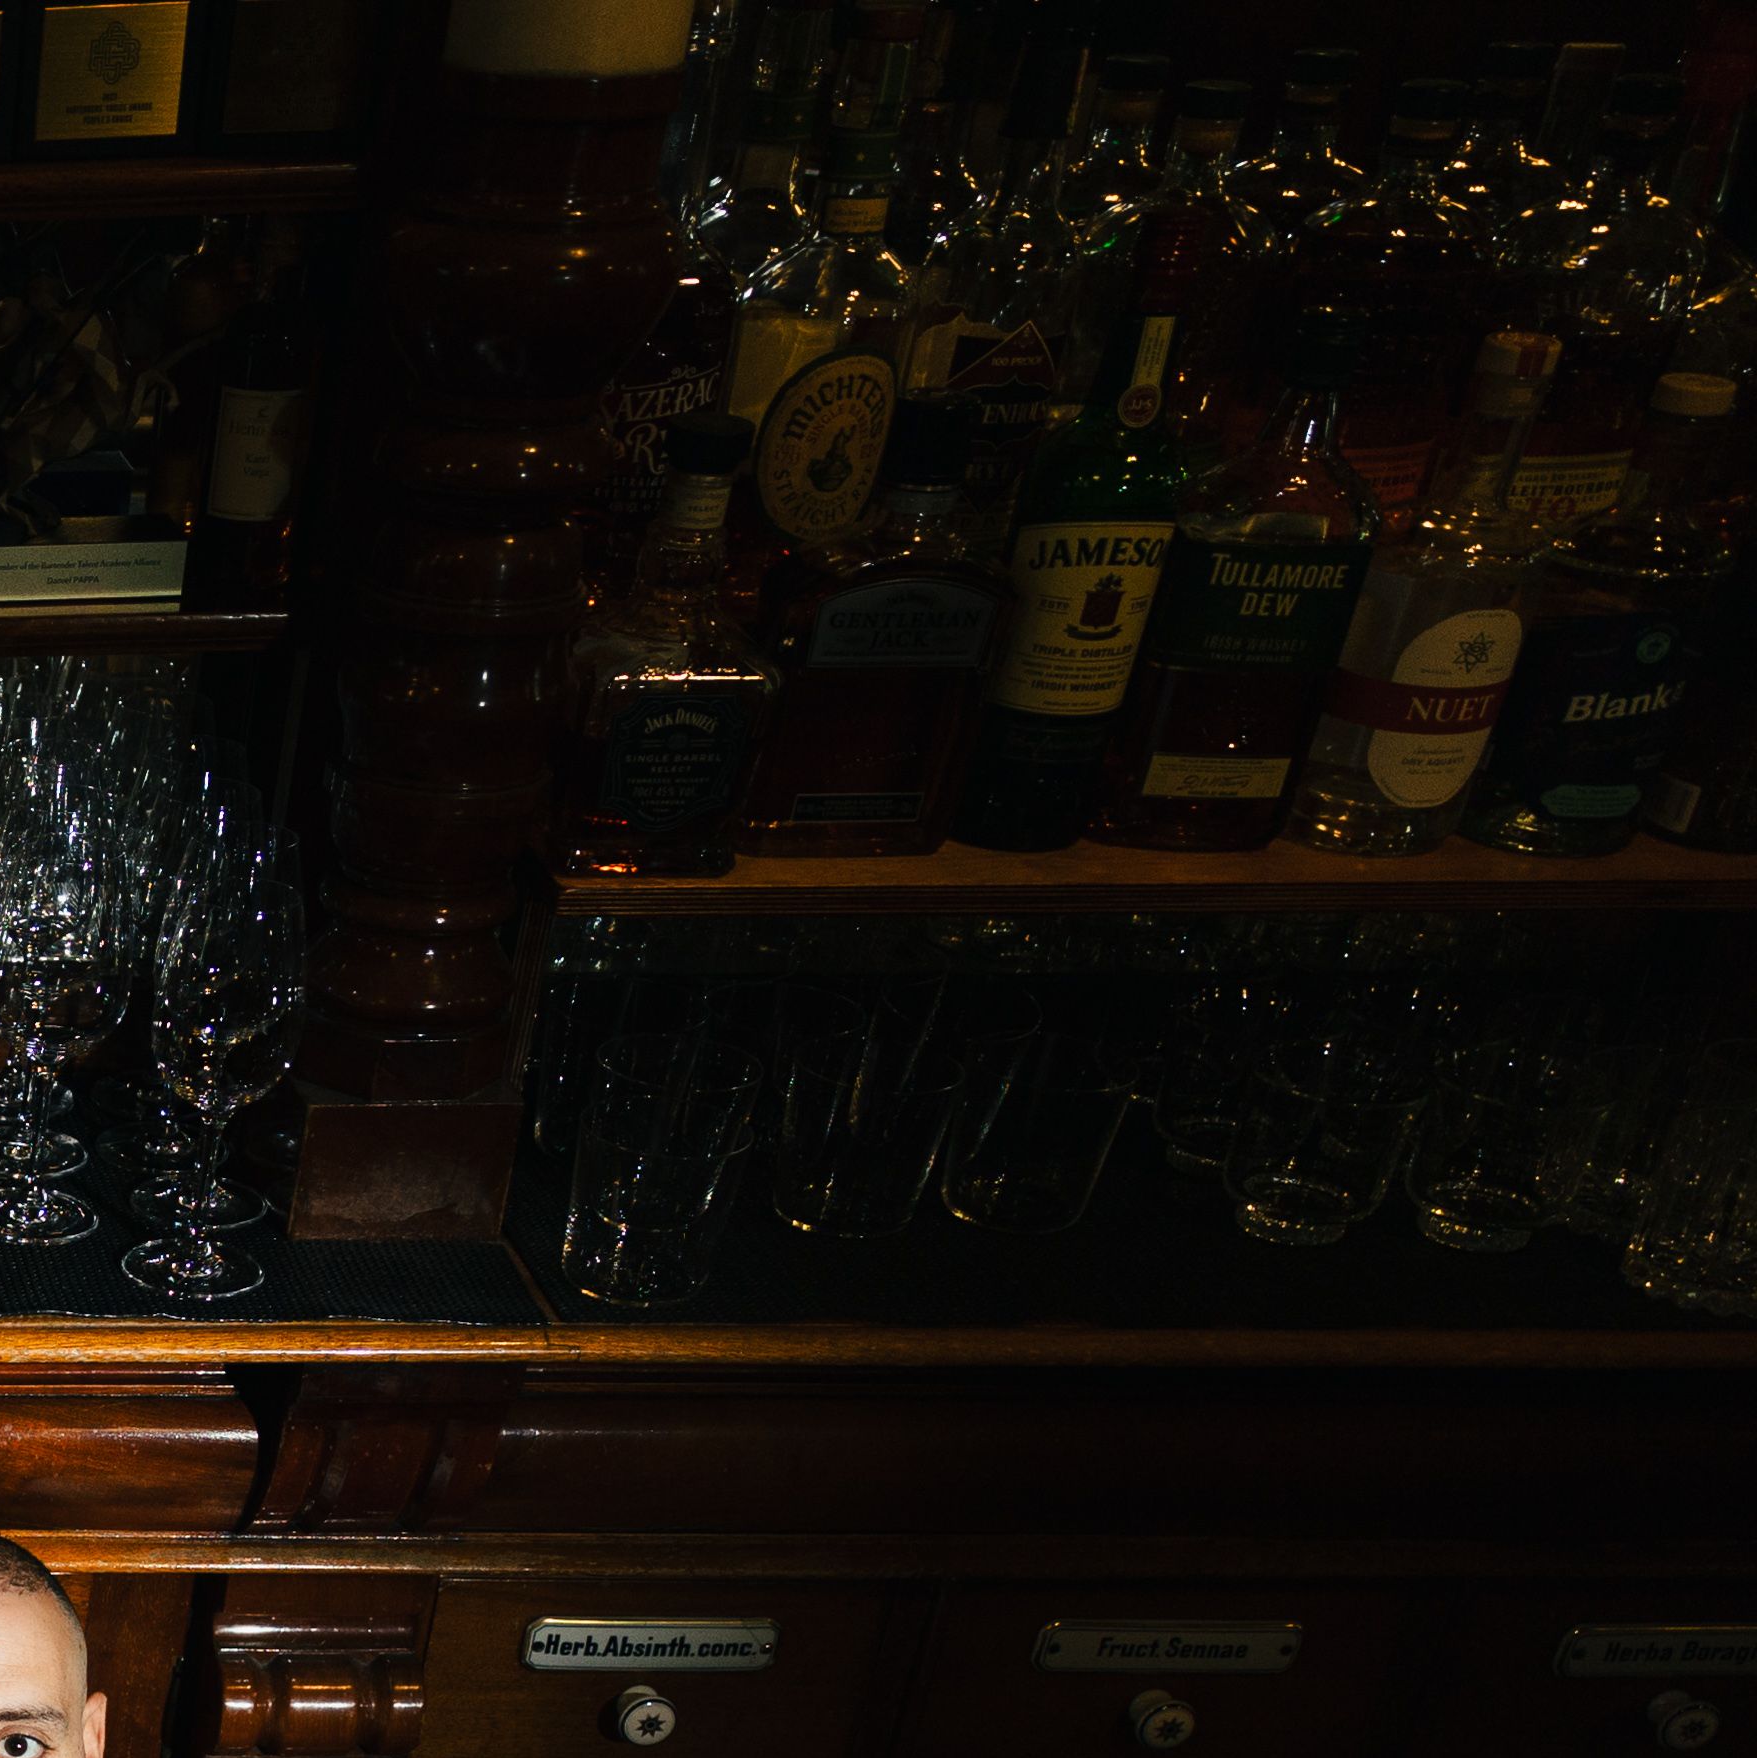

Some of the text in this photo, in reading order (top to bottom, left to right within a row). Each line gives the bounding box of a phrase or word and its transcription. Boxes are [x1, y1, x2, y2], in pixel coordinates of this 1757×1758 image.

[1028, 536, 1167, 570] JAMESO
[1209, 552, 1350, 589] TULLAMORE
[1238, 591, 1301, 618] DEW
[830, 609, 982, 629] GENTLEMAN
[869, 630, 931, 650] JACK
[1204, 633, 1243, 649] IRISH
[1404, 693, 1496, 723] NUET
[645, 711, 675, 736] JACK
[1097, 1637, 1249, 1660] Fruct. Sennae
[1603, 1641, 1673, 1664] Herba
